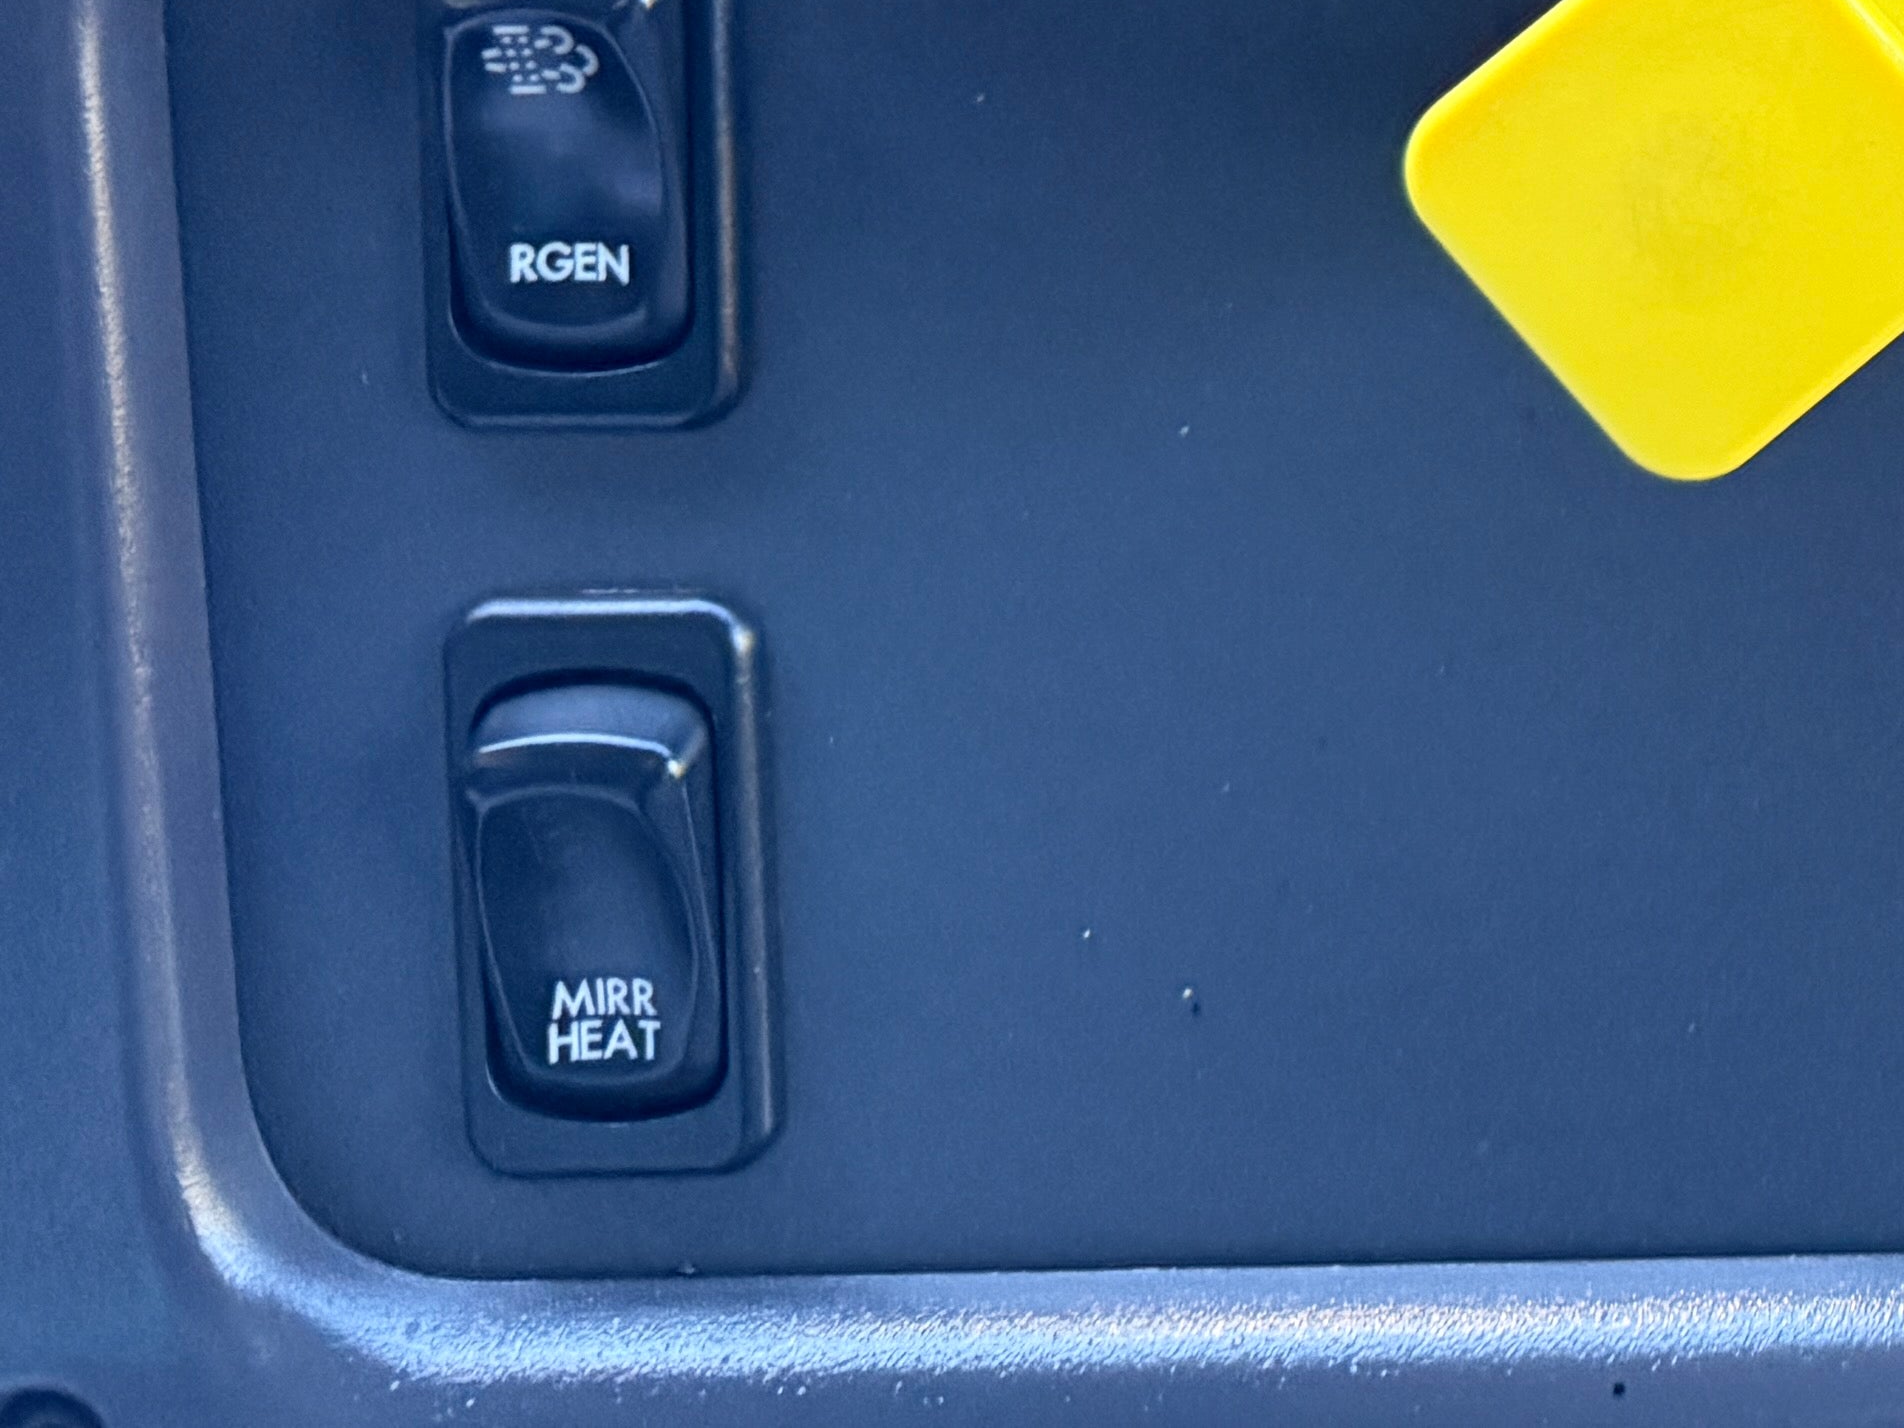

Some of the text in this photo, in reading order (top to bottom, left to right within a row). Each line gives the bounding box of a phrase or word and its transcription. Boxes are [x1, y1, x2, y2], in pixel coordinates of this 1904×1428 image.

[508, 241, 631, 286] RGEN
[550, 977, 659, 1020] MIRR
[547, 1017, 662, 1065] HEAT
